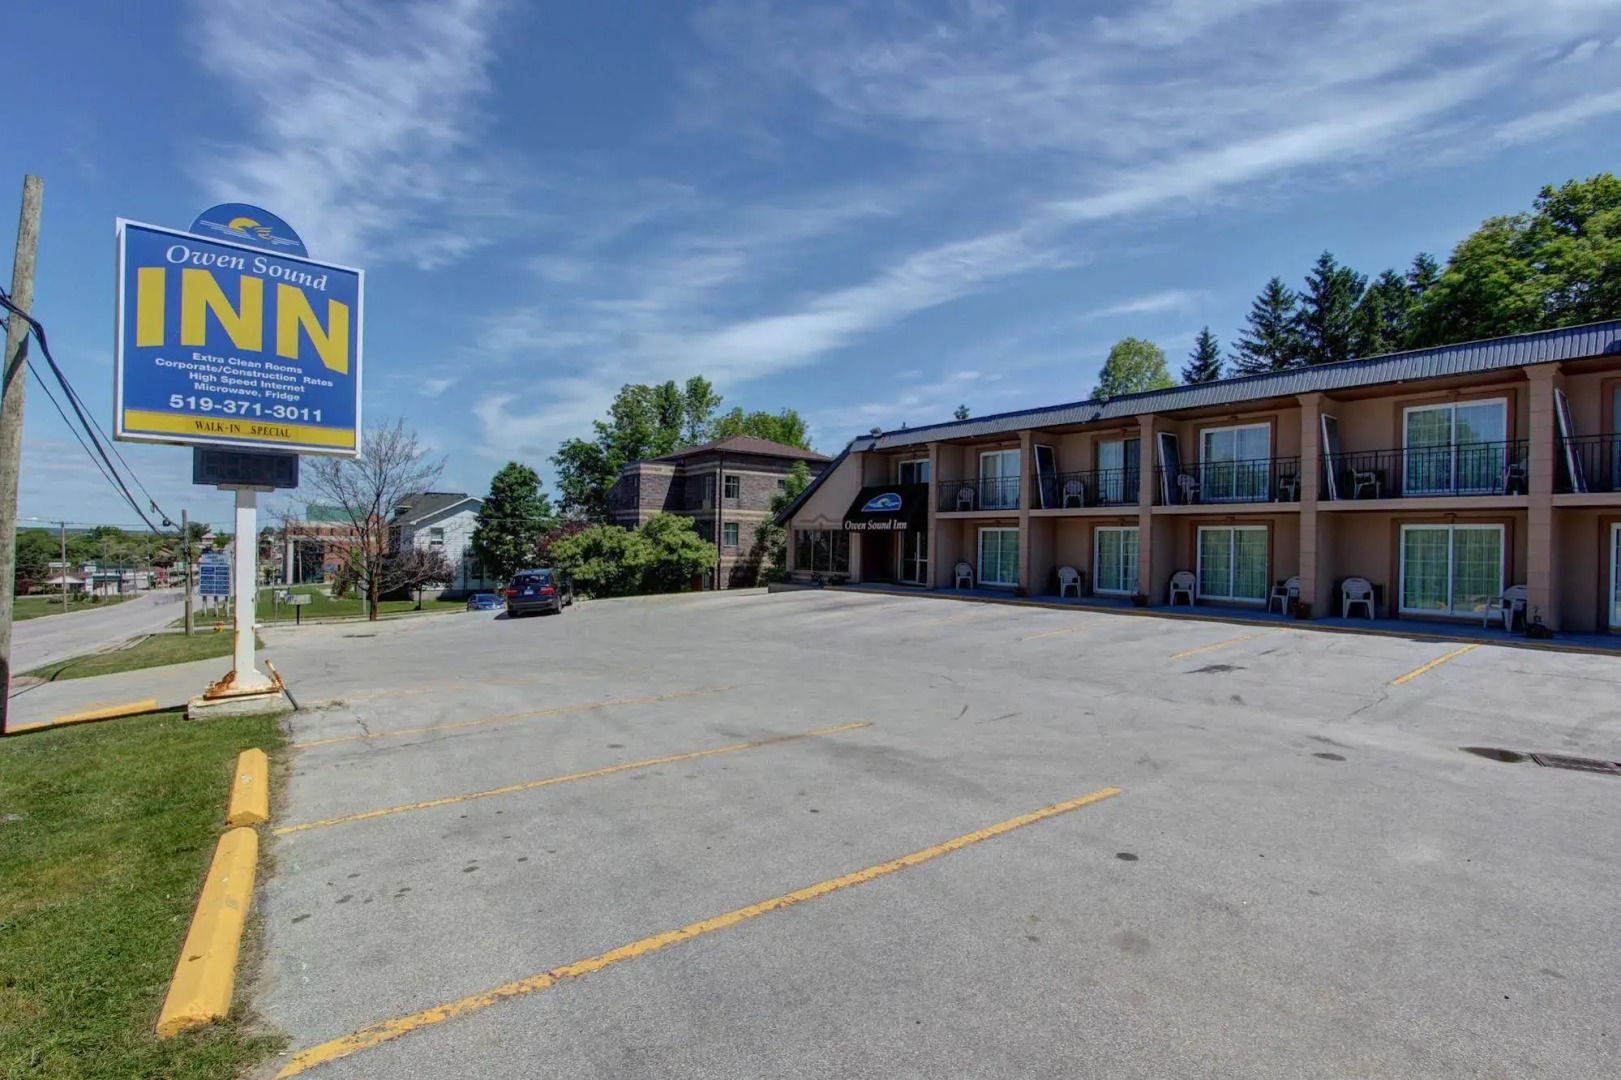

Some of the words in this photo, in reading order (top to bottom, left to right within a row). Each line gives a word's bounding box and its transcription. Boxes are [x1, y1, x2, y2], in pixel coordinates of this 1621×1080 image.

[166, 245, 245, 270] Owen
[252, 257, 328, 291] Sound
[136, 267, 349, 375] INN
[155, 358, 297, 382] Corporate/Construction
[303, 376, 333, 387] Rates
[192, 352, 225, 364] Extra
[228, 357, 262, 369] Clean
[265, 362, 303, 374] Rooms
[189, 371, 217, 382] High
[220, 375, 257, 387] Speed
[261, 380, 305, 393] Internet
[194, 382, 261, 398] Microwave,
[265, 390, 300, 402] Fridge
[169, 394, 322, 422] 519-371-3011
[195, 420, 241, 433] WALK-IN
[251, 425, 291, 438] SPECIAL
[845, 520, 867, 530] Owen
[867, 519, 892, 530] Sound
[892, 519, 907, 530] Inn
